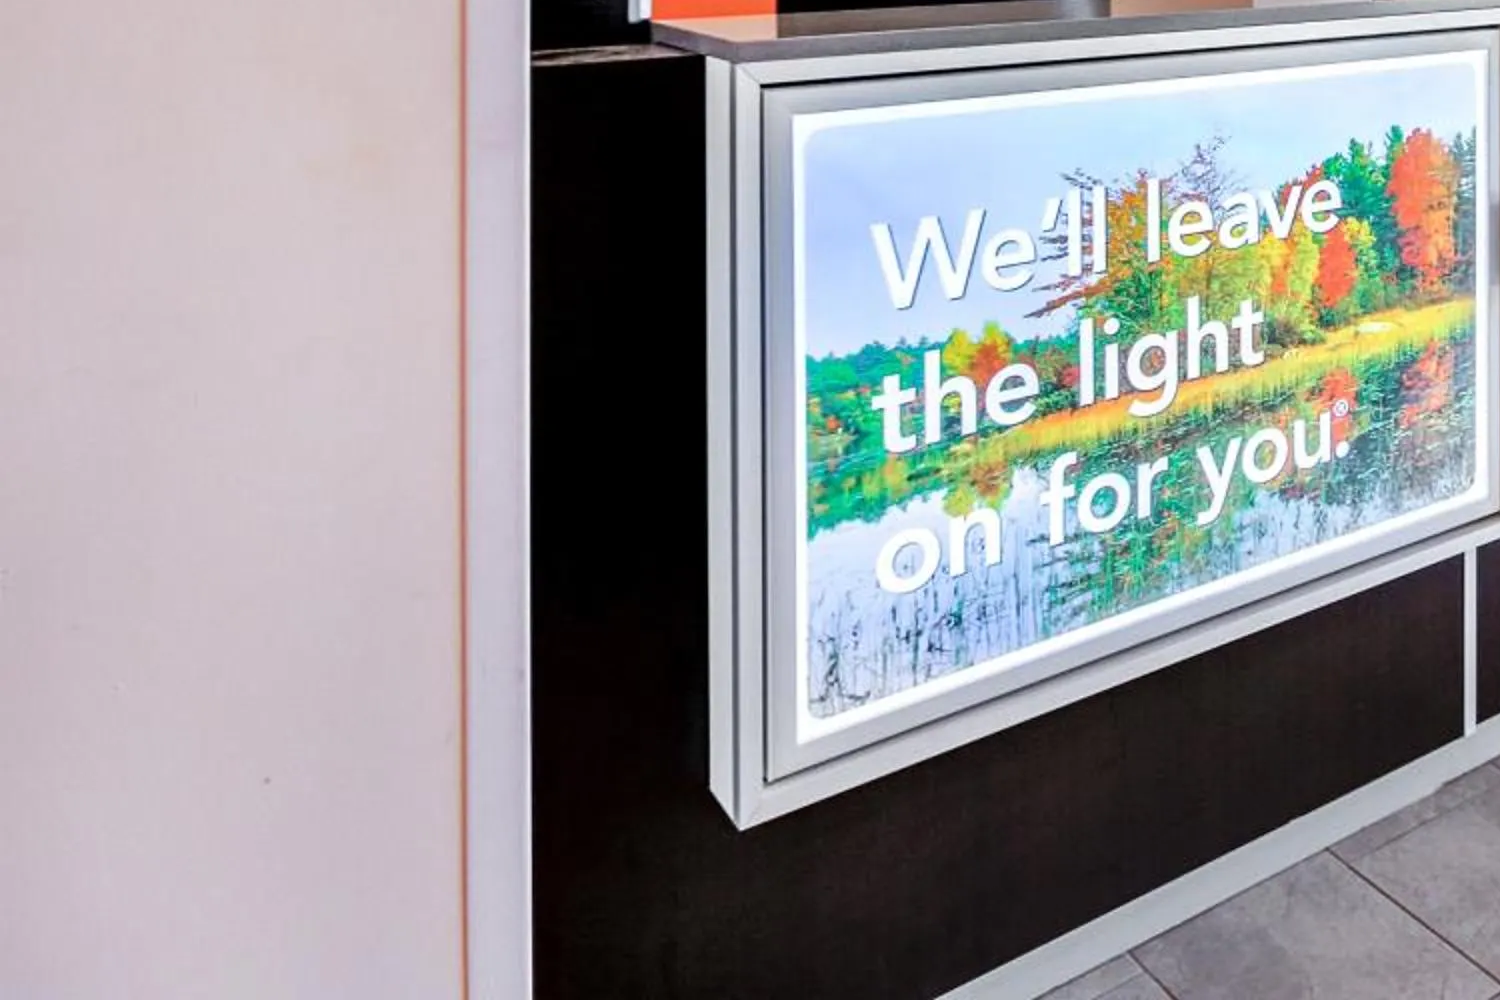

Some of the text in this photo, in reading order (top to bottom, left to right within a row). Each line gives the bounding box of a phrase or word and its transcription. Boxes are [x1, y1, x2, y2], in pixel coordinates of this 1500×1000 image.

[870, 178, 1342, 310] We'll leave
[871, 296, 1266, 454] the light
[875, 508, 1002, 595] on
[1039, 452, 1169, 546] for
